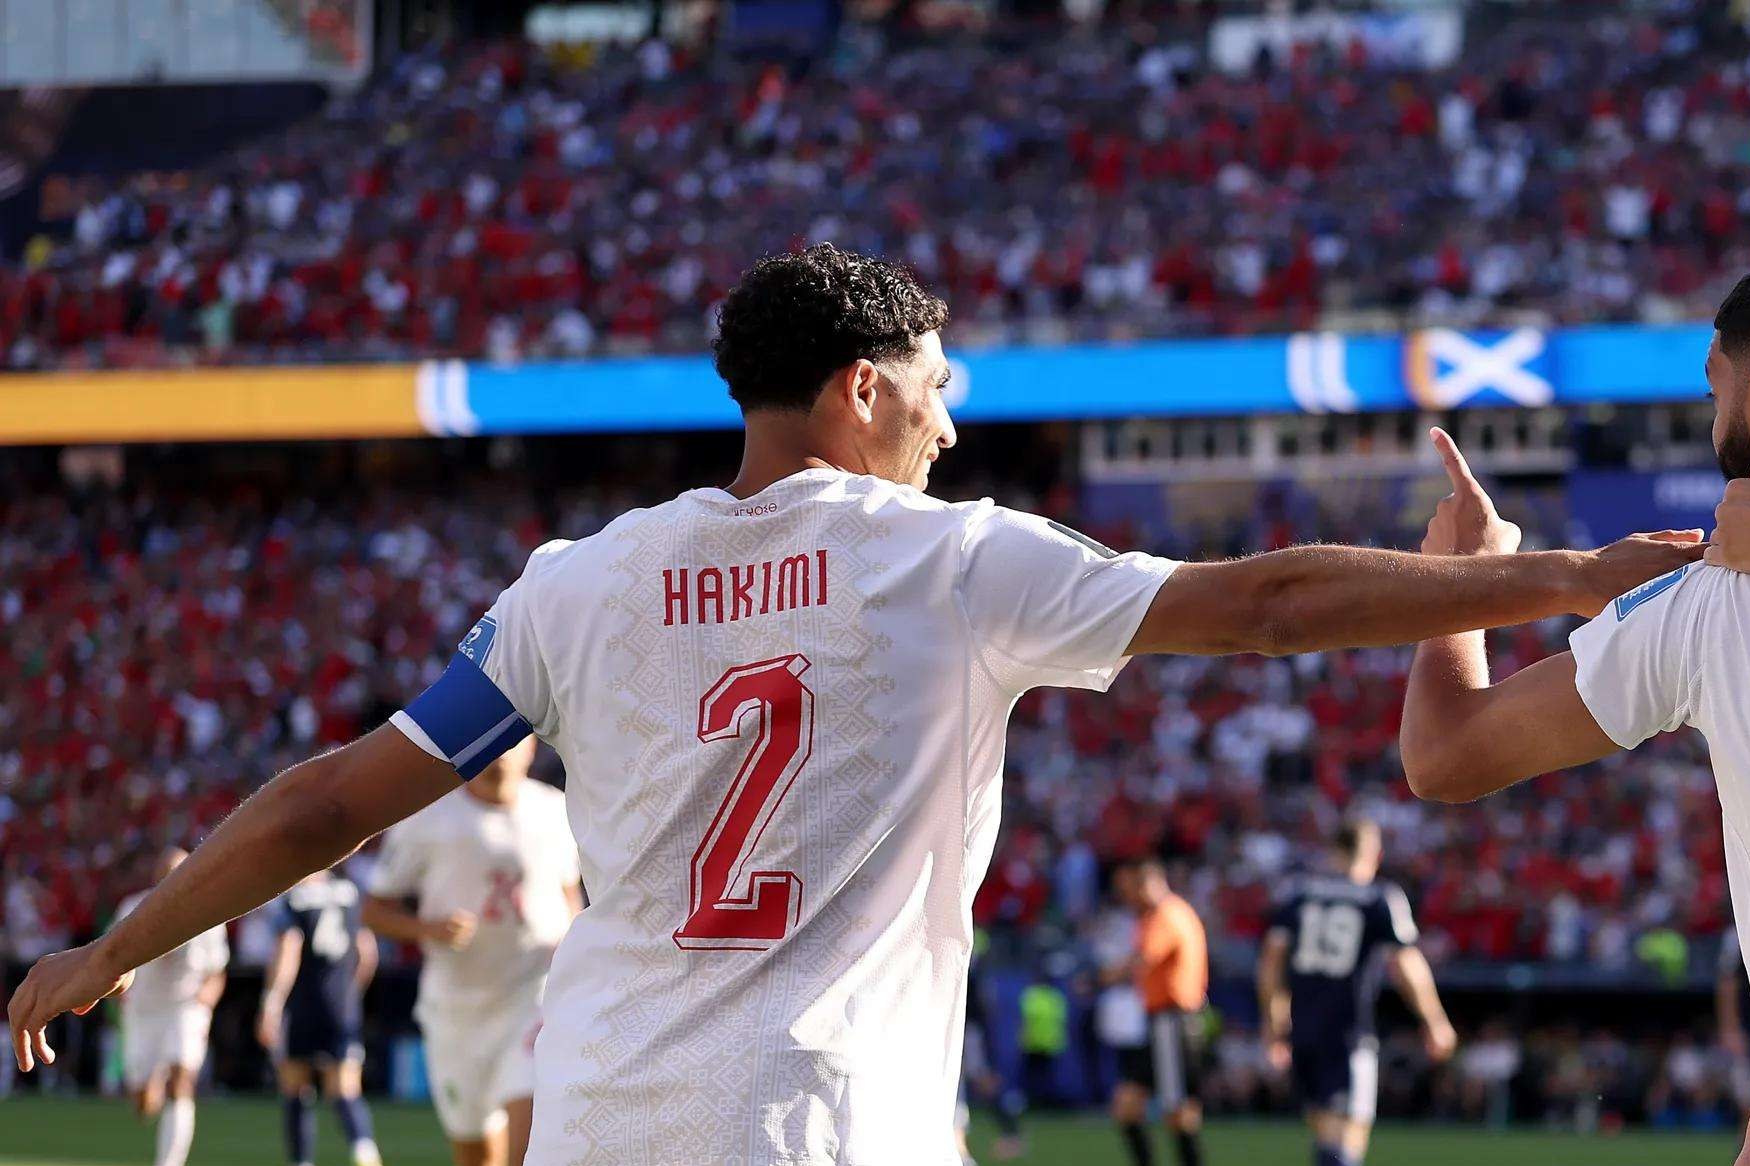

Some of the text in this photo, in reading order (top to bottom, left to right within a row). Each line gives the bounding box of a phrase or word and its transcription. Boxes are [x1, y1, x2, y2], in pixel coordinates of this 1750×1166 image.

[662, 549, 828, 627] HAKIMI
[672, 652, 815, 951] 2
[1293, 902, 1365, 978] 19
